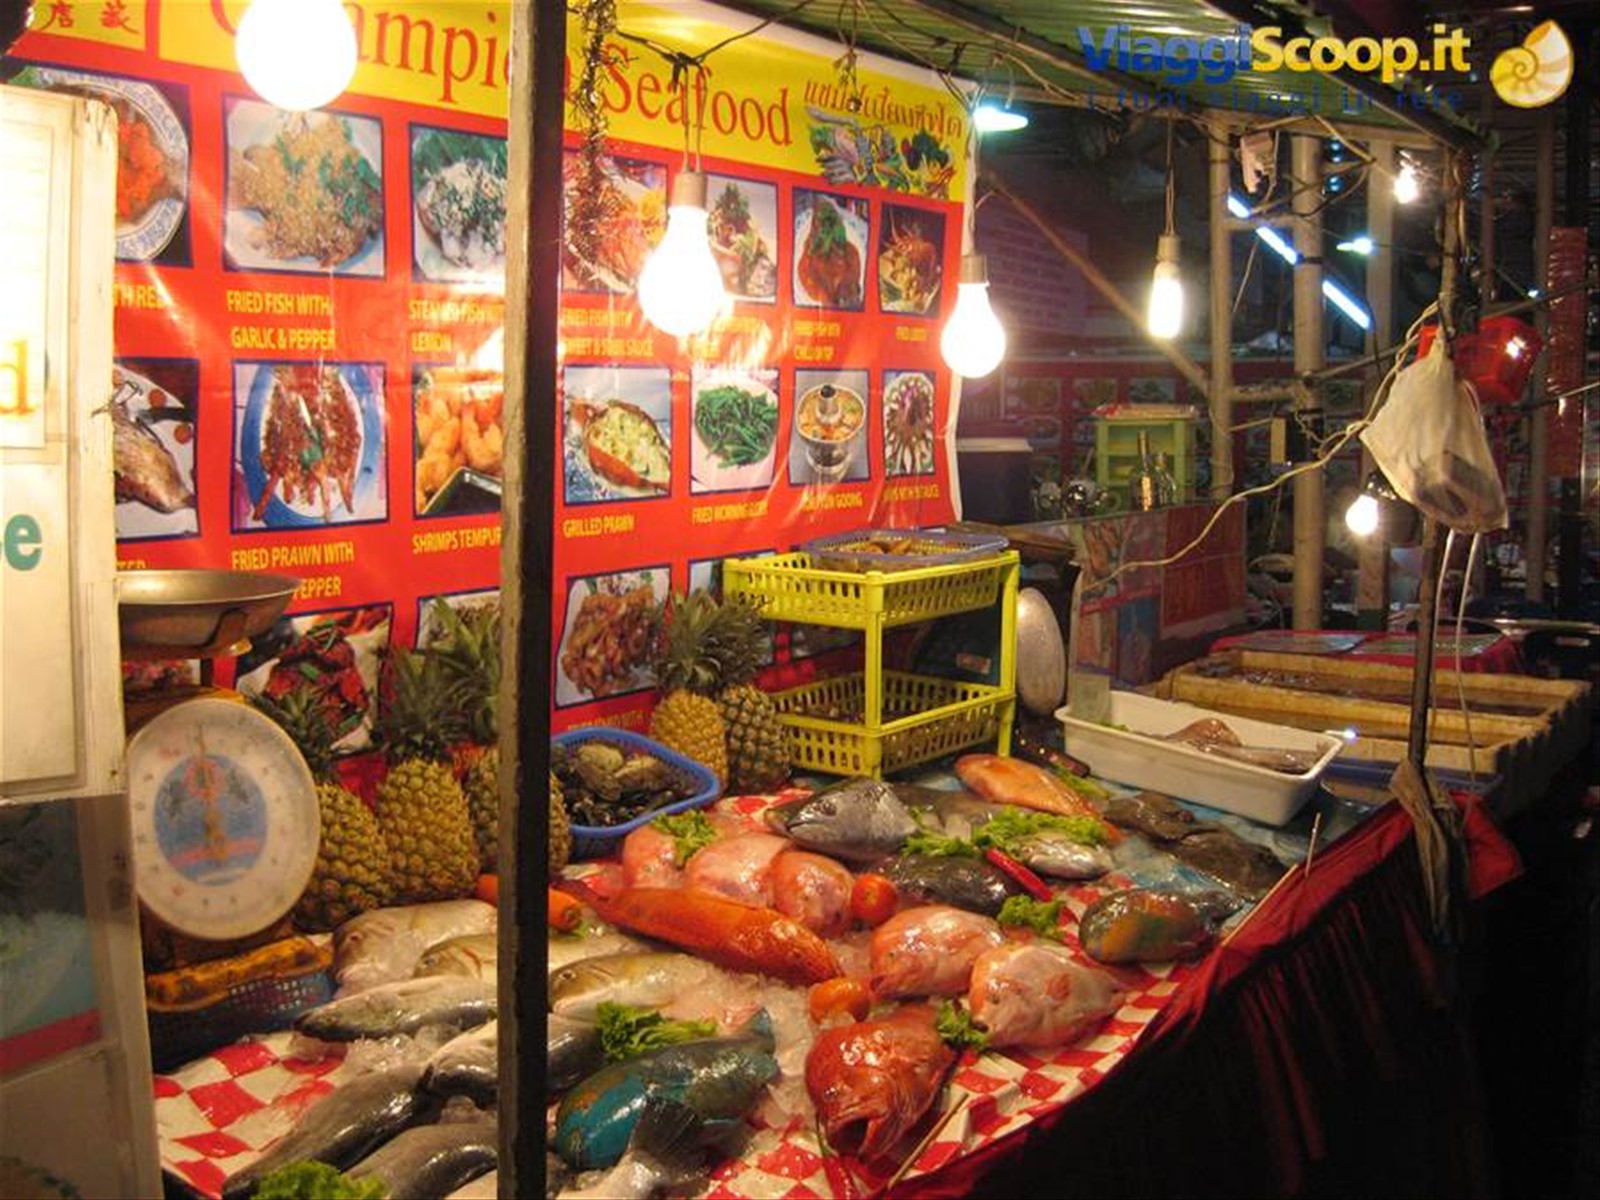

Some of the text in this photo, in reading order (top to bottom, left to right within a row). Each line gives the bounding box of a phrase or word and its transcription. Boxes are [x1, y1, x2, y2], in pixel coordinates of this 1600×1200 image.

[601, 43, 793, 145] Seafood
[226, 290, 333, 315] FRIED FISH WITH
[231, 326, 337, 351] GARLIC & PEPPER
[411, 332, 453, 352] LEMON
[563, 515, 635, 538] GRILLED PRAWN
[692, 507, 713, 525] FRIED
[412, 530, 459, 554] SHRIMPS
[231, 541, 355, 571] FRIED PRAWN WITH
